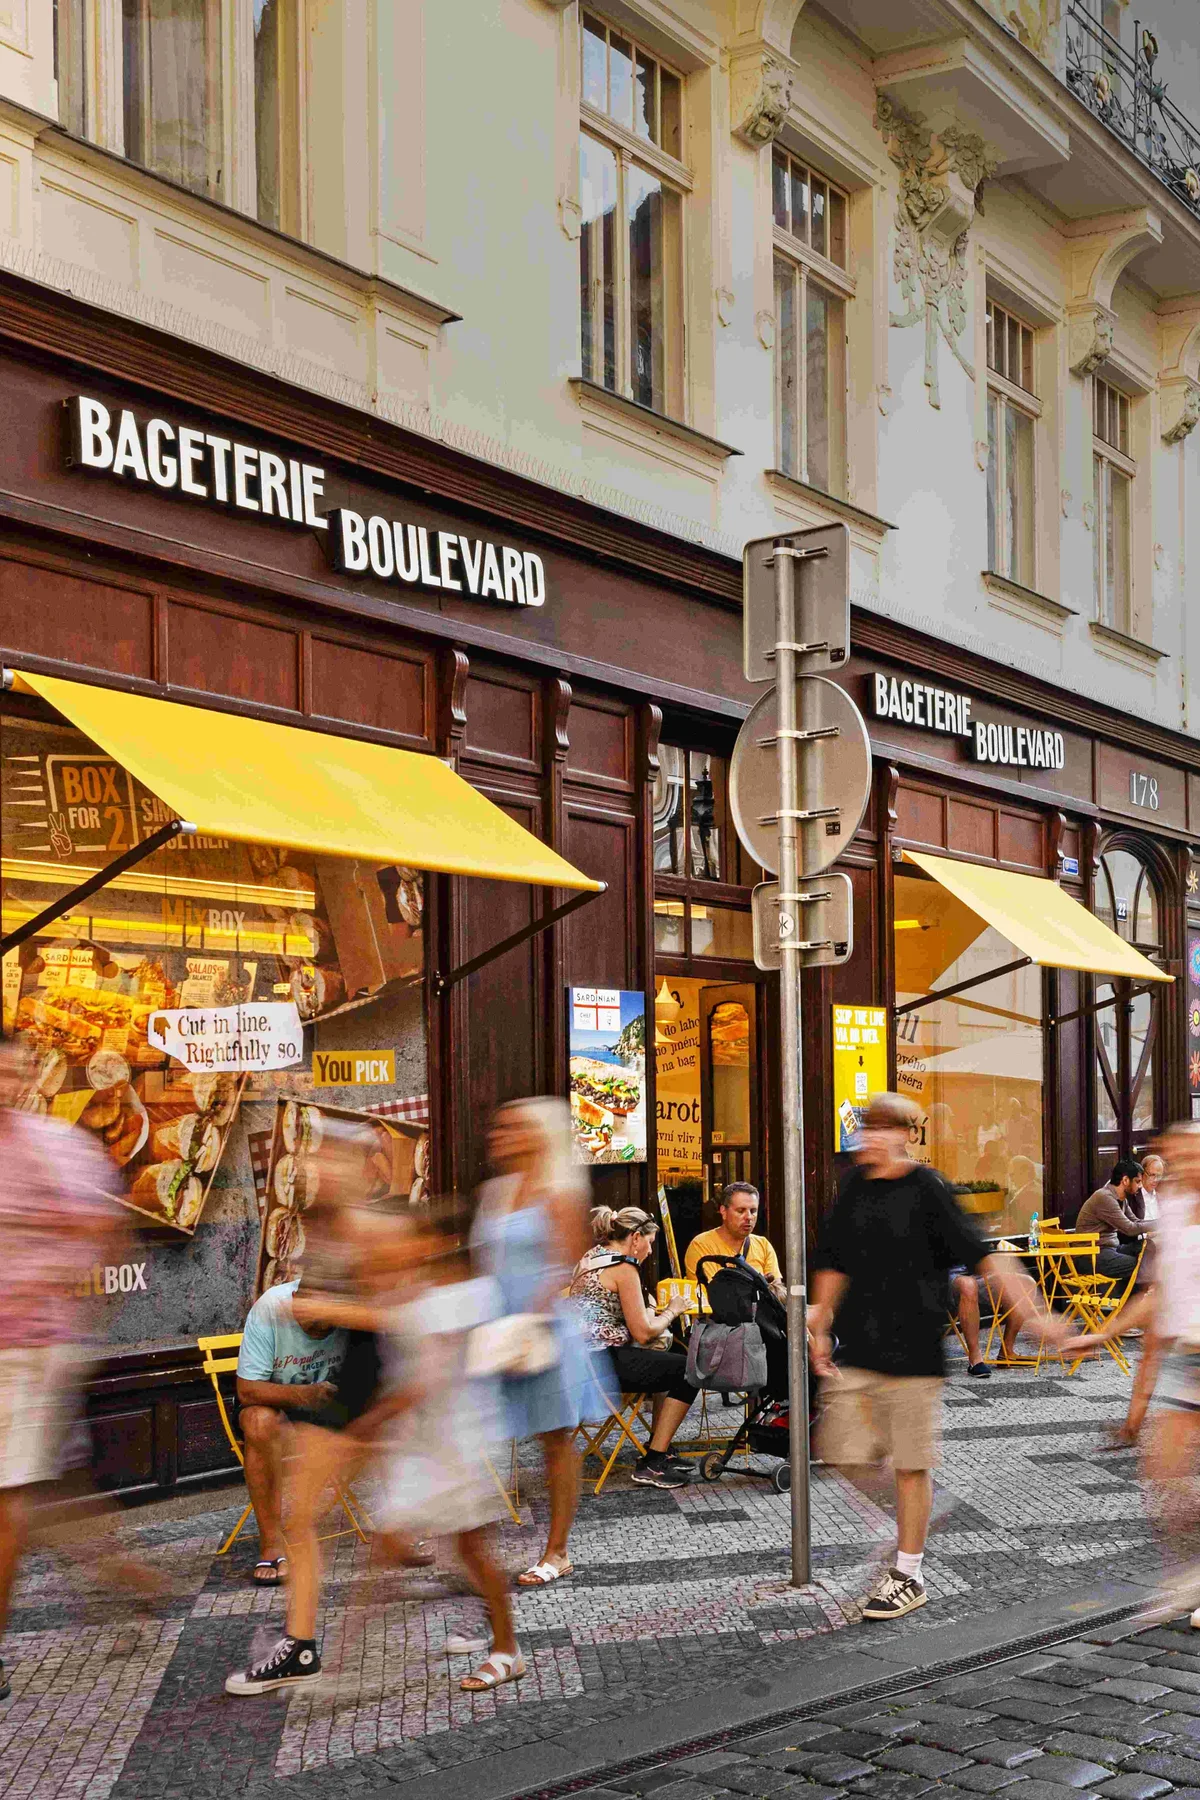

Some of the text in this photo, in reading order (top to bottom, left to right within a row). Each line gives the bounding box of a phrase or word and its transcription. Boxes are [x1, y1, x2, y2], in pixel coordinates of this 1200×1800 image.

[76, 395, 329, 530] BAGETERIE
[340, 508, 547, 608] BOULEVARD
[874, 673, 973, 738] BAGETERIE
[975, 721, 1066, 770] BOULEVARD
[62, 766, 121, 804] BOX
[1132, 772, 1159, 810] 178
[68, 806, 129, 851] FOR 2
[1117, 902, 1127, 917] 22
[188, 963, 217, 975] SALADS
[576, 993, 616, 1003] SARDINIAN
[177, 1012, 272, 1037] Cut in line.
[185, 1039, 301, 1069] Rightfully so.
[316, 1055, 389, 1083] You PICK
[677, 1131, 695, 1144] vliv
[673, 1146, 689, 1160] tak
[302, 1360, 325, 1372] LAGER
